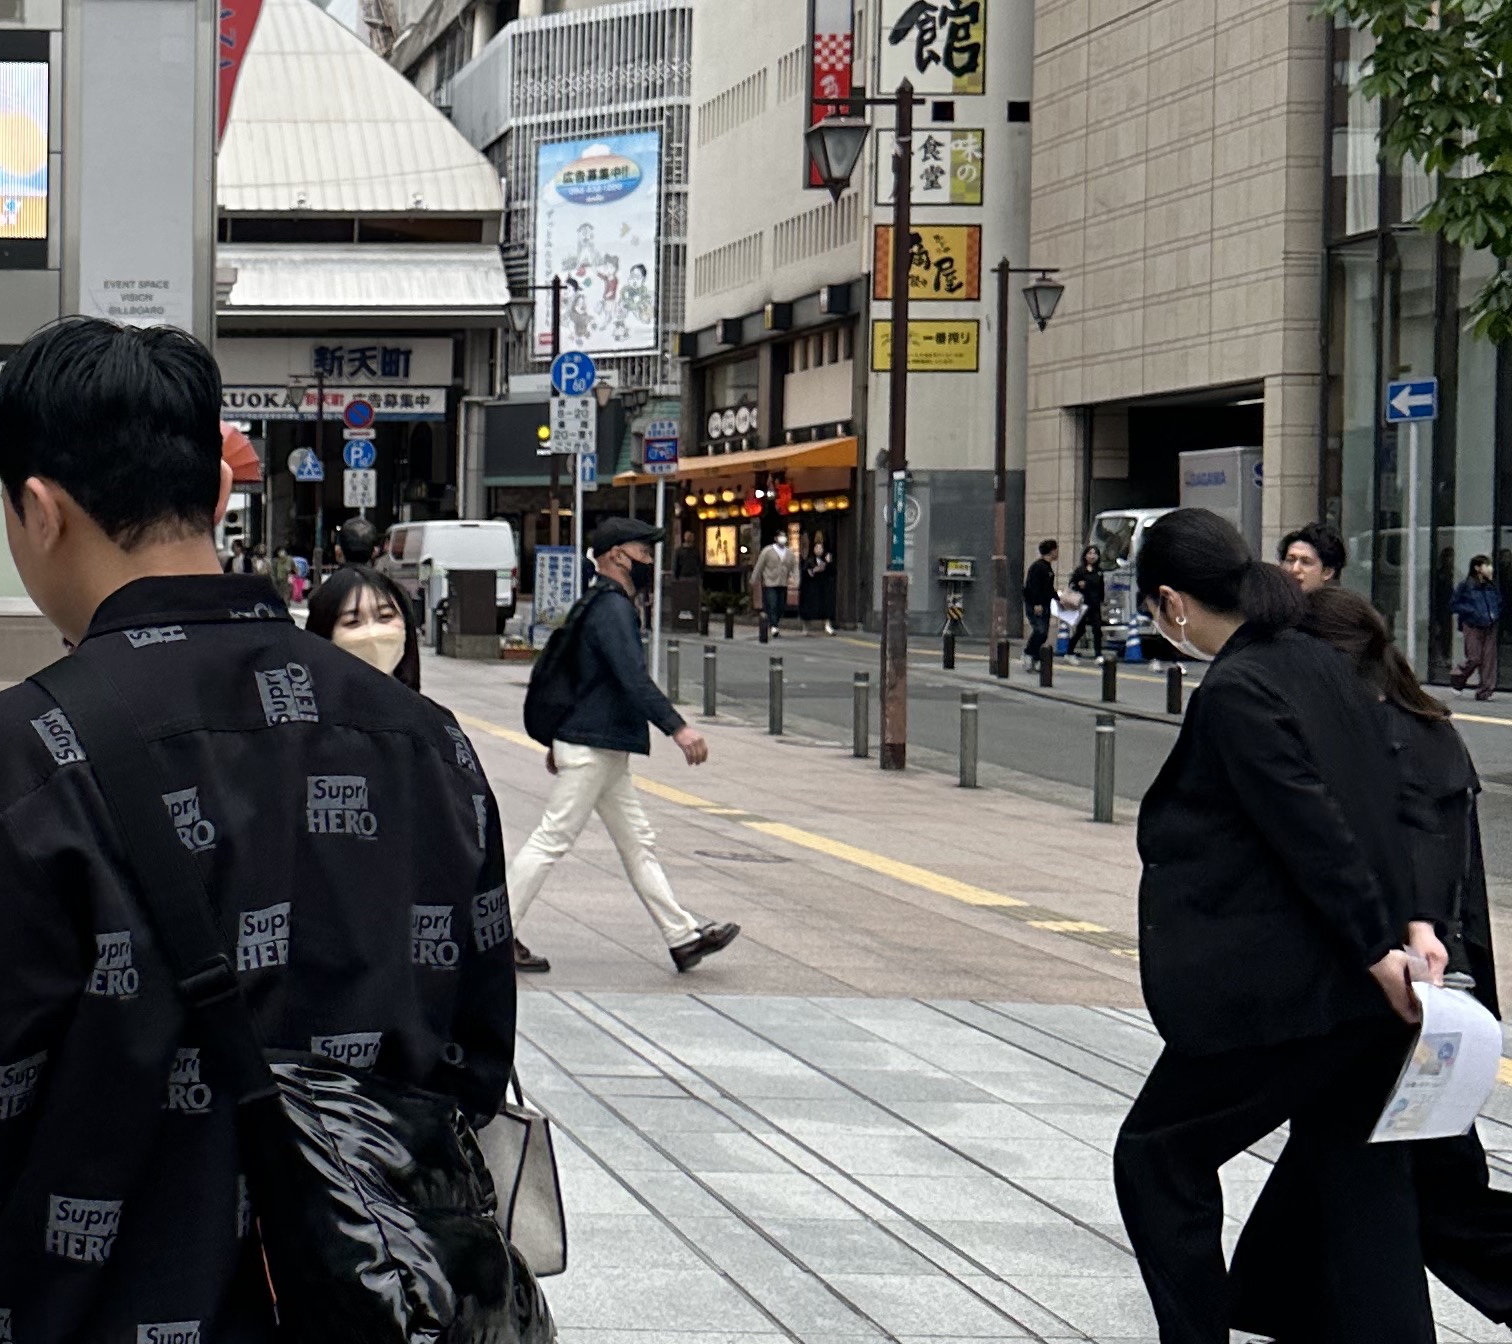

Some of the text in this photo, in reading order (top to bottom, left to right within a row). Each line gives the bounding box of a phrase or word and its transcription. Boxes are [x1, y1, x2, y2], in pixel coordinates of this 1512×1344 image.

[919, 134, 946, 192] 食堂
[951, 133, 982, 183] 味の
[103, 280, 169, 290] EVENT SPACE
[313, 344, 413, 379] 新天町
[561, 362, 579, 391] P
[222, 392, 291, 408] KUOK
[175, 819, 217, 852] RO
[306, 809, 378, 845] HERO
[243, 913, 289, 937] Sup
[88, 966, 139, 996] ERO
[168, 1083, 213, 1110] RO
